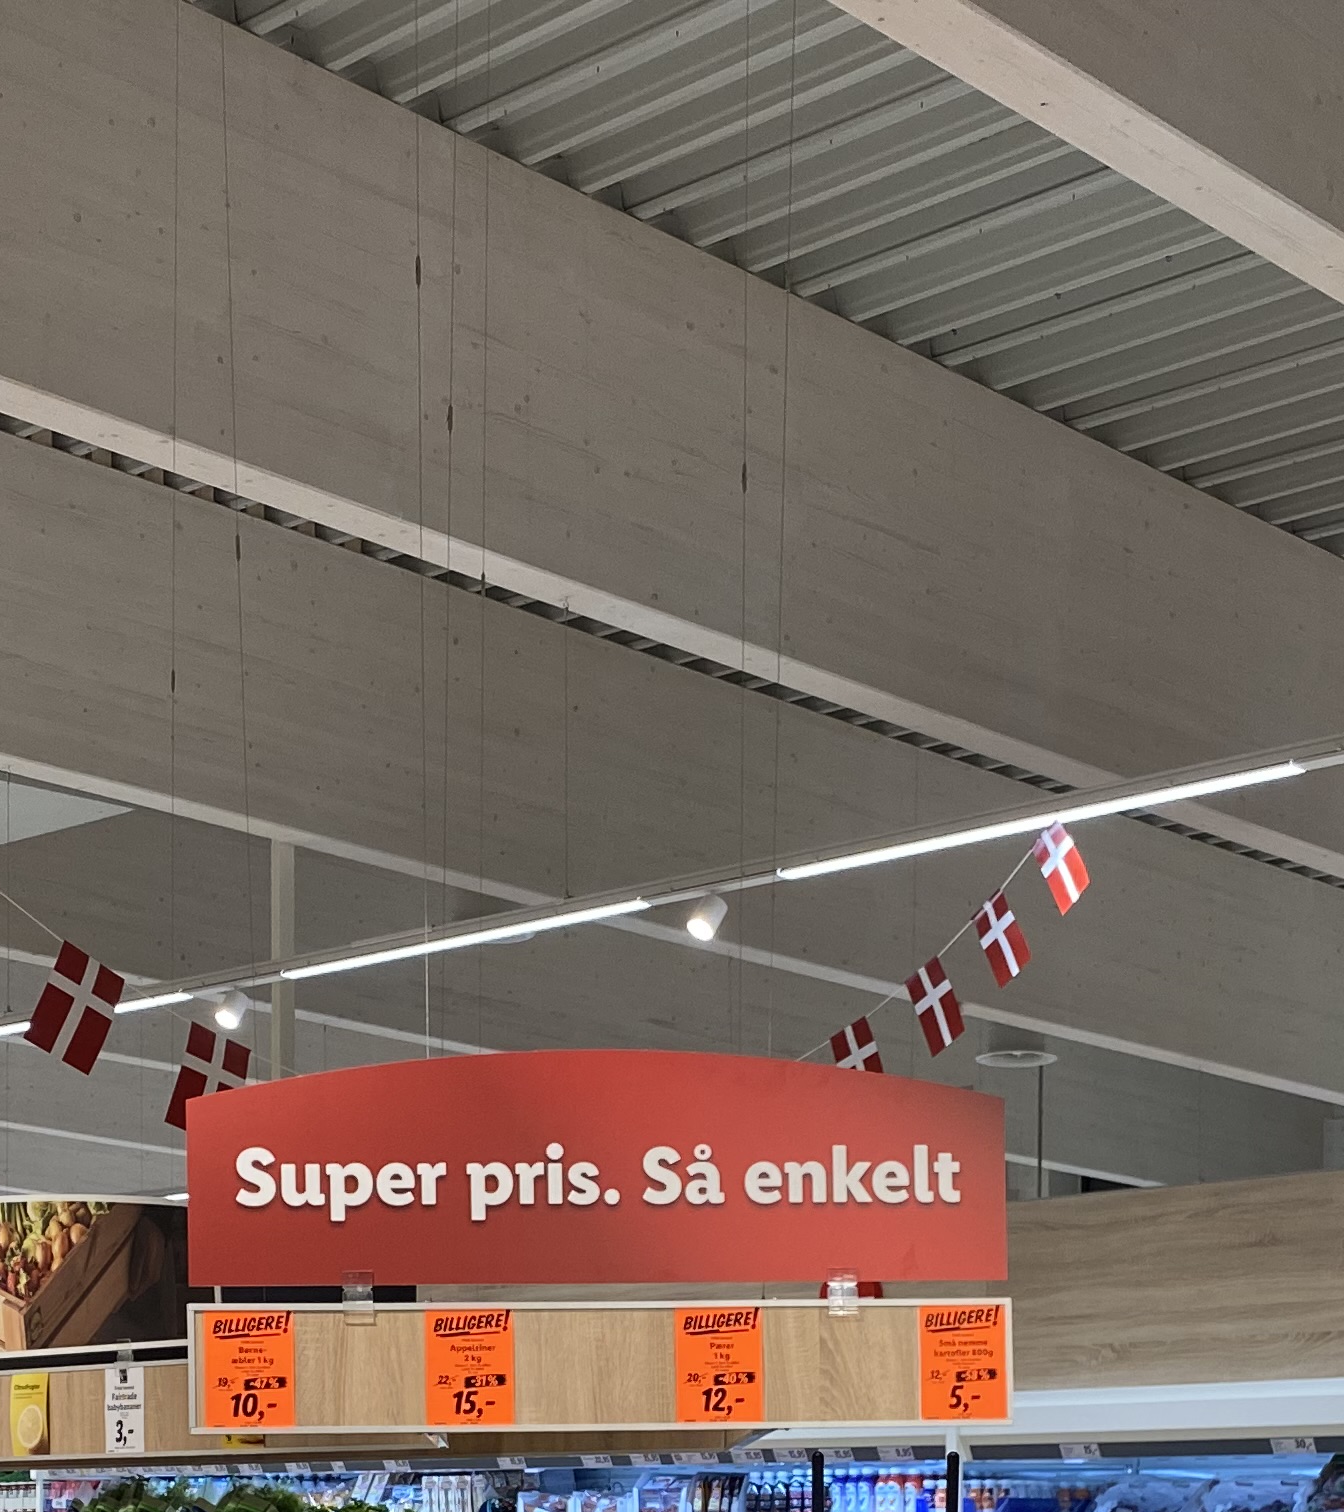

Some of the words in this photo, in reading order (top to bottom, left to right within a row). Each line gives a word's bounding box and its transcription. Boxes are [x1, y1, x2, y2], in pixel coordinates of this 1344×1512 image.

[235, 1147, 446, 1221] Super
[467, 1142, 620, 1221] pris.
[643, 1144, 724, 1205] Så
[745, 1144, 961, 1204] enkelt
[213, 1310, 292, 1334] BILLIGERE!
[434, 1310, 510, 1332] BILLIGERE!
[684, 1307, 759, 1330] BILLIGERE!
[925, 1305, 999, 1327] BILLIGERE!
[450, 1344, 495, 1353] Appelsiner
[471, 1355, 481, 1363] kg
[720, 1352, 730, 1360] kg
[264, 1357, 274, 1366] kg
[230, 1393, 277, 1421] 10,-
[453, 1391, 495, 1418] 15,-
[702, 1388, 744, 1415] 12,-
[949, 1385, 980, 1412] 5,-
[116, 1420, 133, 1446] 3,-
